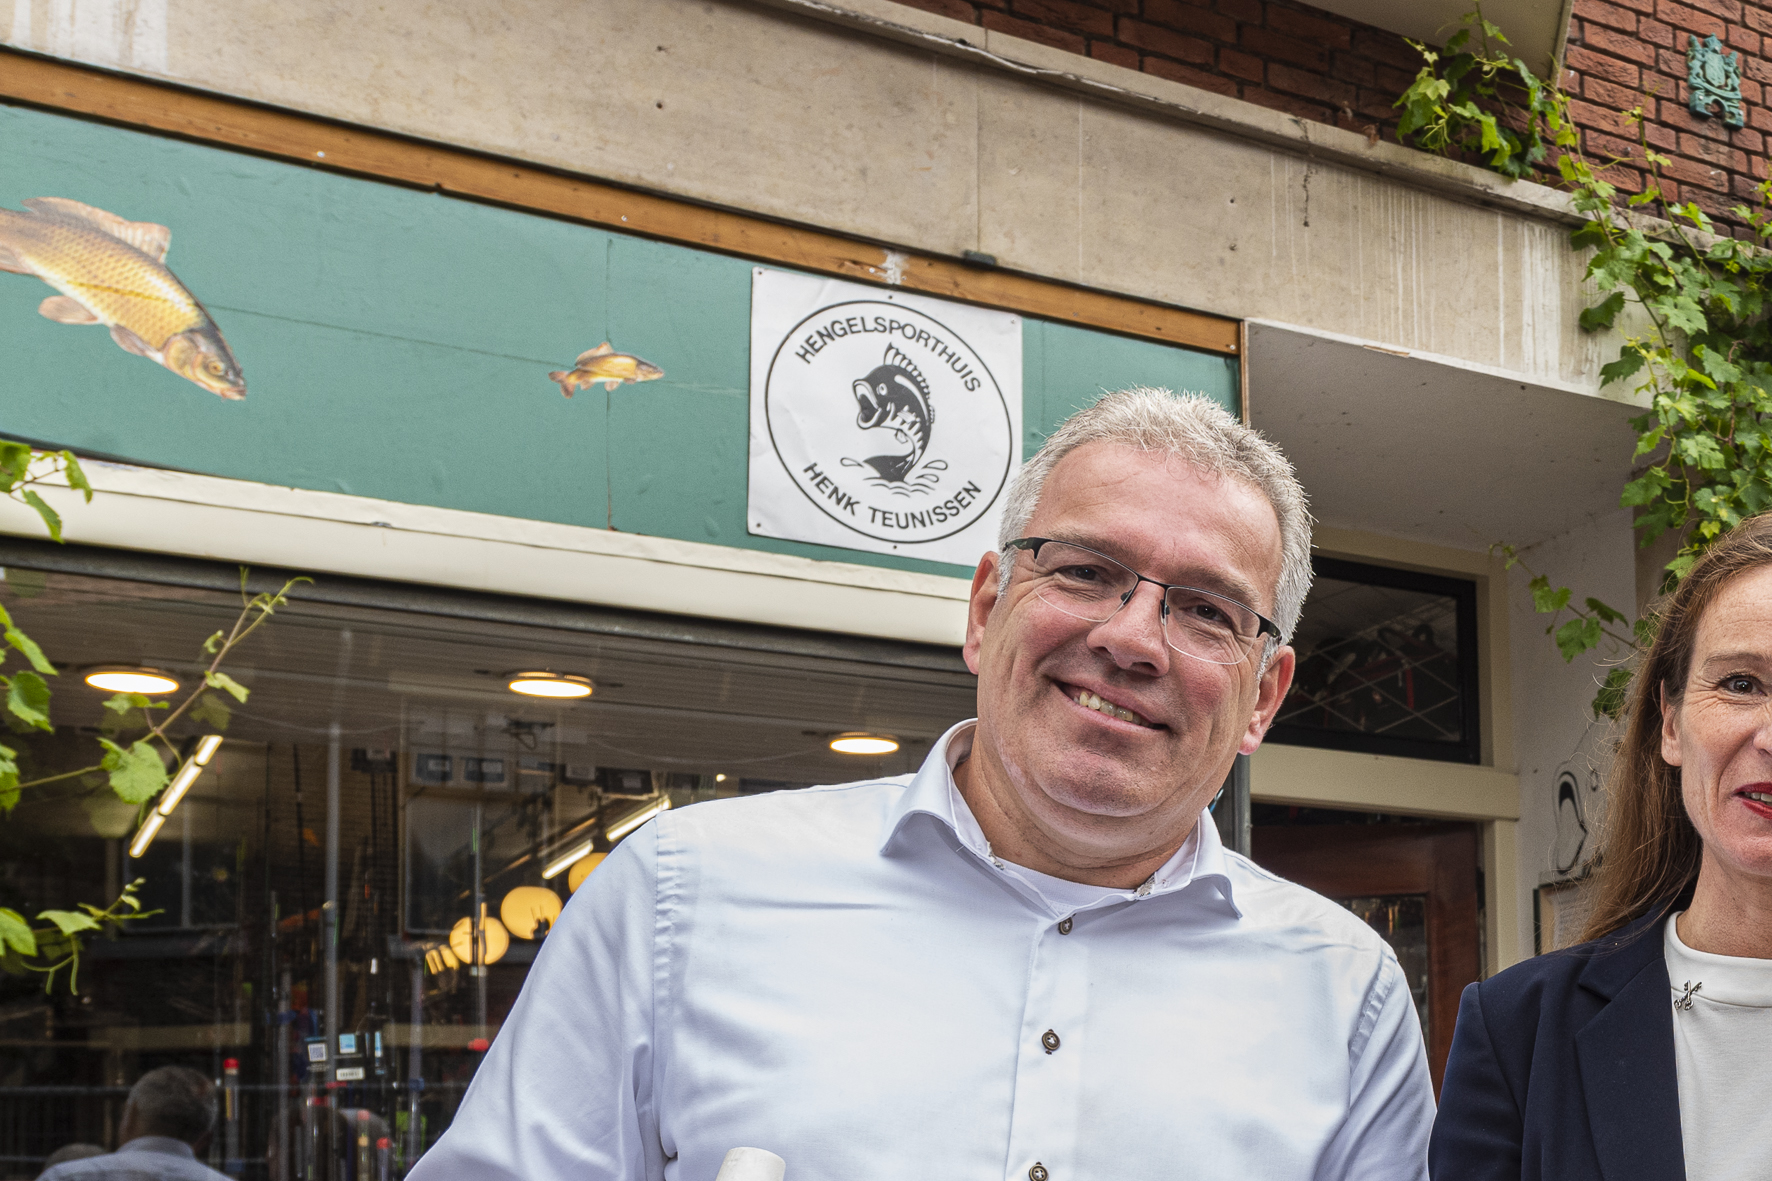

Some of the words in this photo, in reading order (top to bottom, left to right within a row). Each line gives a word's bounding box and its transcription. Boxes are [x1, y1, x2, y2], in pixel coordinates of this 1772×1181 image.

[795, 316, 981, 393] HENGELSPORTHUIS
[803, 462, 861, 516] HENK
[868, 480, 982, 529] TEUNISSEN
